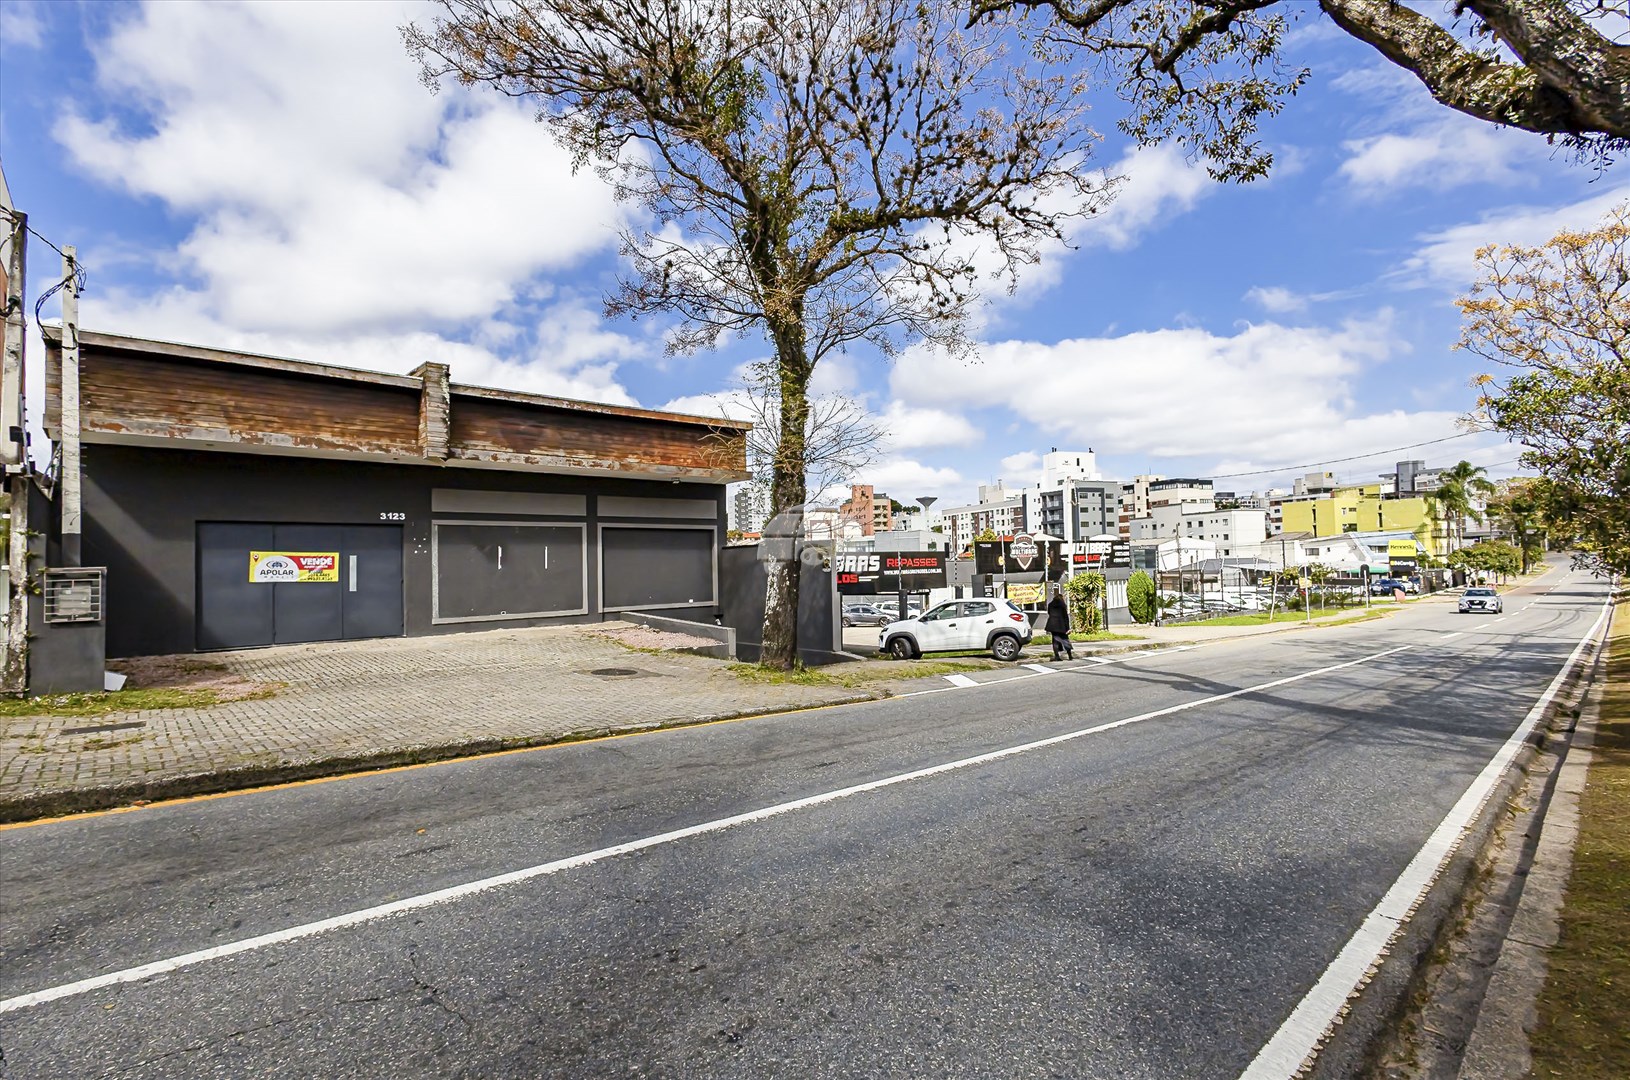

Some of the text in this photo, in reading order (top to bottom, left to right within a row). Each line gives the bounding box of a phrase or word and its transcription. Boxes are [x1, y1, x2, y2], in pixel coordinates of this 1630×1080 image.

[380, 512, 406, 520] 3123
[300, 556, 333, 566] VENDE
[886, 558, 938, 567] REPASSES
